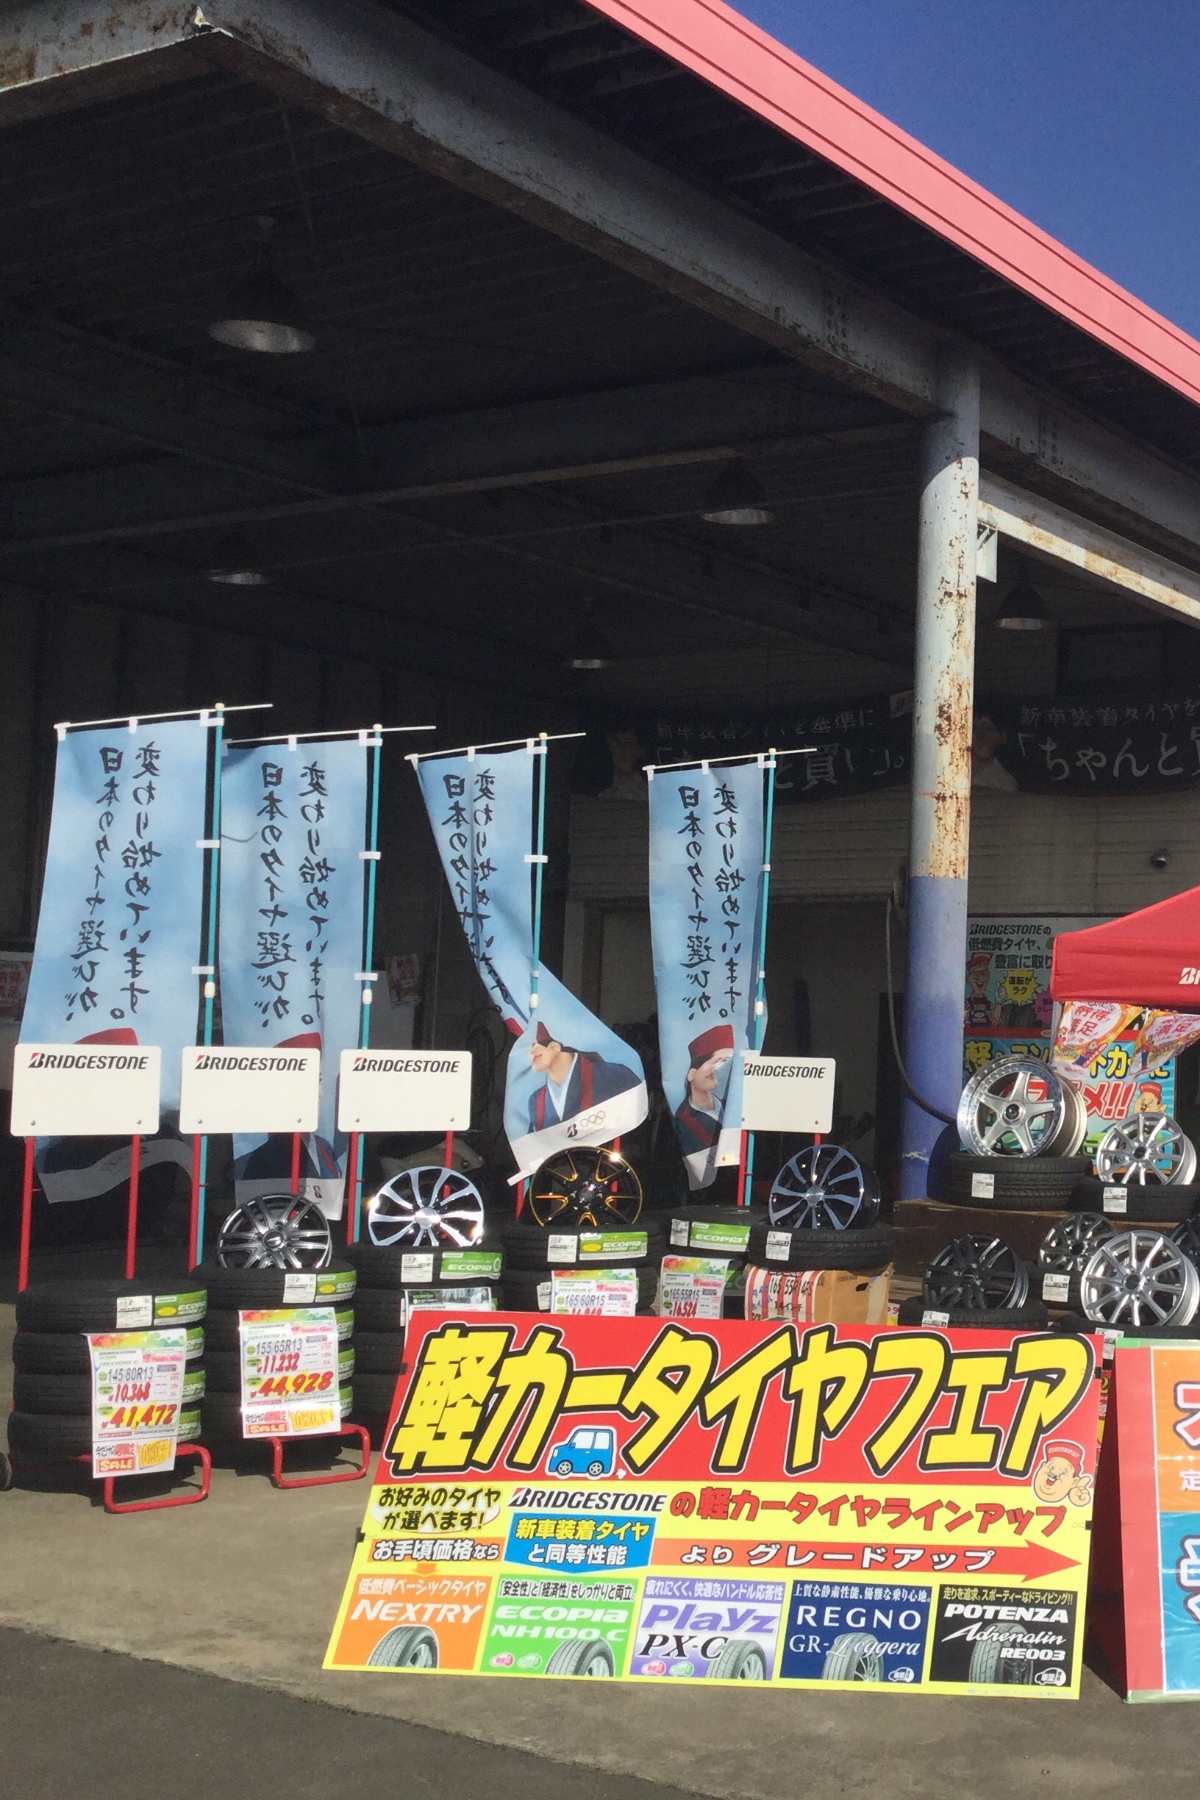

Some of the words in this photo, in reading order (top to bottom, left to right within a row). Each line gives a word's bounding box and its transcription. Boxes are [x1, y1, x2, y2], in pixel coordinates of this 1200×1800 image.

[27, 1051, 148, 1072] BRIDGESTONE
[193, 1053, 308, 1073] BRIDGESTONE
[351, 1055, 461, 1074] BRIDGESTONE
[742, 1063, 826, 1079] BRIDGESTONE
[695, 1234, 743, 1243] ECOPIA
[448, 1263, 493, 1271] ECOPIA
[391, 1323, 1094, 1475] 軽カータイヤフェア
[99, 1458, 134, 1472] SALE
[378, 1486, 502, 1508] お好みのタイヤ
[508, 1487, 668, 1512] BRIDGESTONE
[382, 1509, 486, 1532] が選べます!
[515, 1518, 650, 1542] 新車装着タイヤ
[372, 1539, 500, 1562] お手頃価格なら
[527, 1542, 629, 1566] と同等性能
[357, 1577, 487, 1598] 低燃費ベーシックタイヤ
[644, 1579, 784, 1601] 疲れにくく、快適なハンドル応答性
[350, 1599, 485, 1625] NEXTRY
[640, 1603, 778, 1634] Playz
[796, 1605, 922, 1630] REGNO
[943, 1603, 1069, 1623] POTENZA
[490, 1624, 595, 1641] NH100
[941, 1621, 1067, 1646] Adrenalin
[638, 1634, 729, 1660] PX-C
[789, 1634, 921, 1658] GR-Leggera
[1000, 1647, 1066, 1661] RE003
